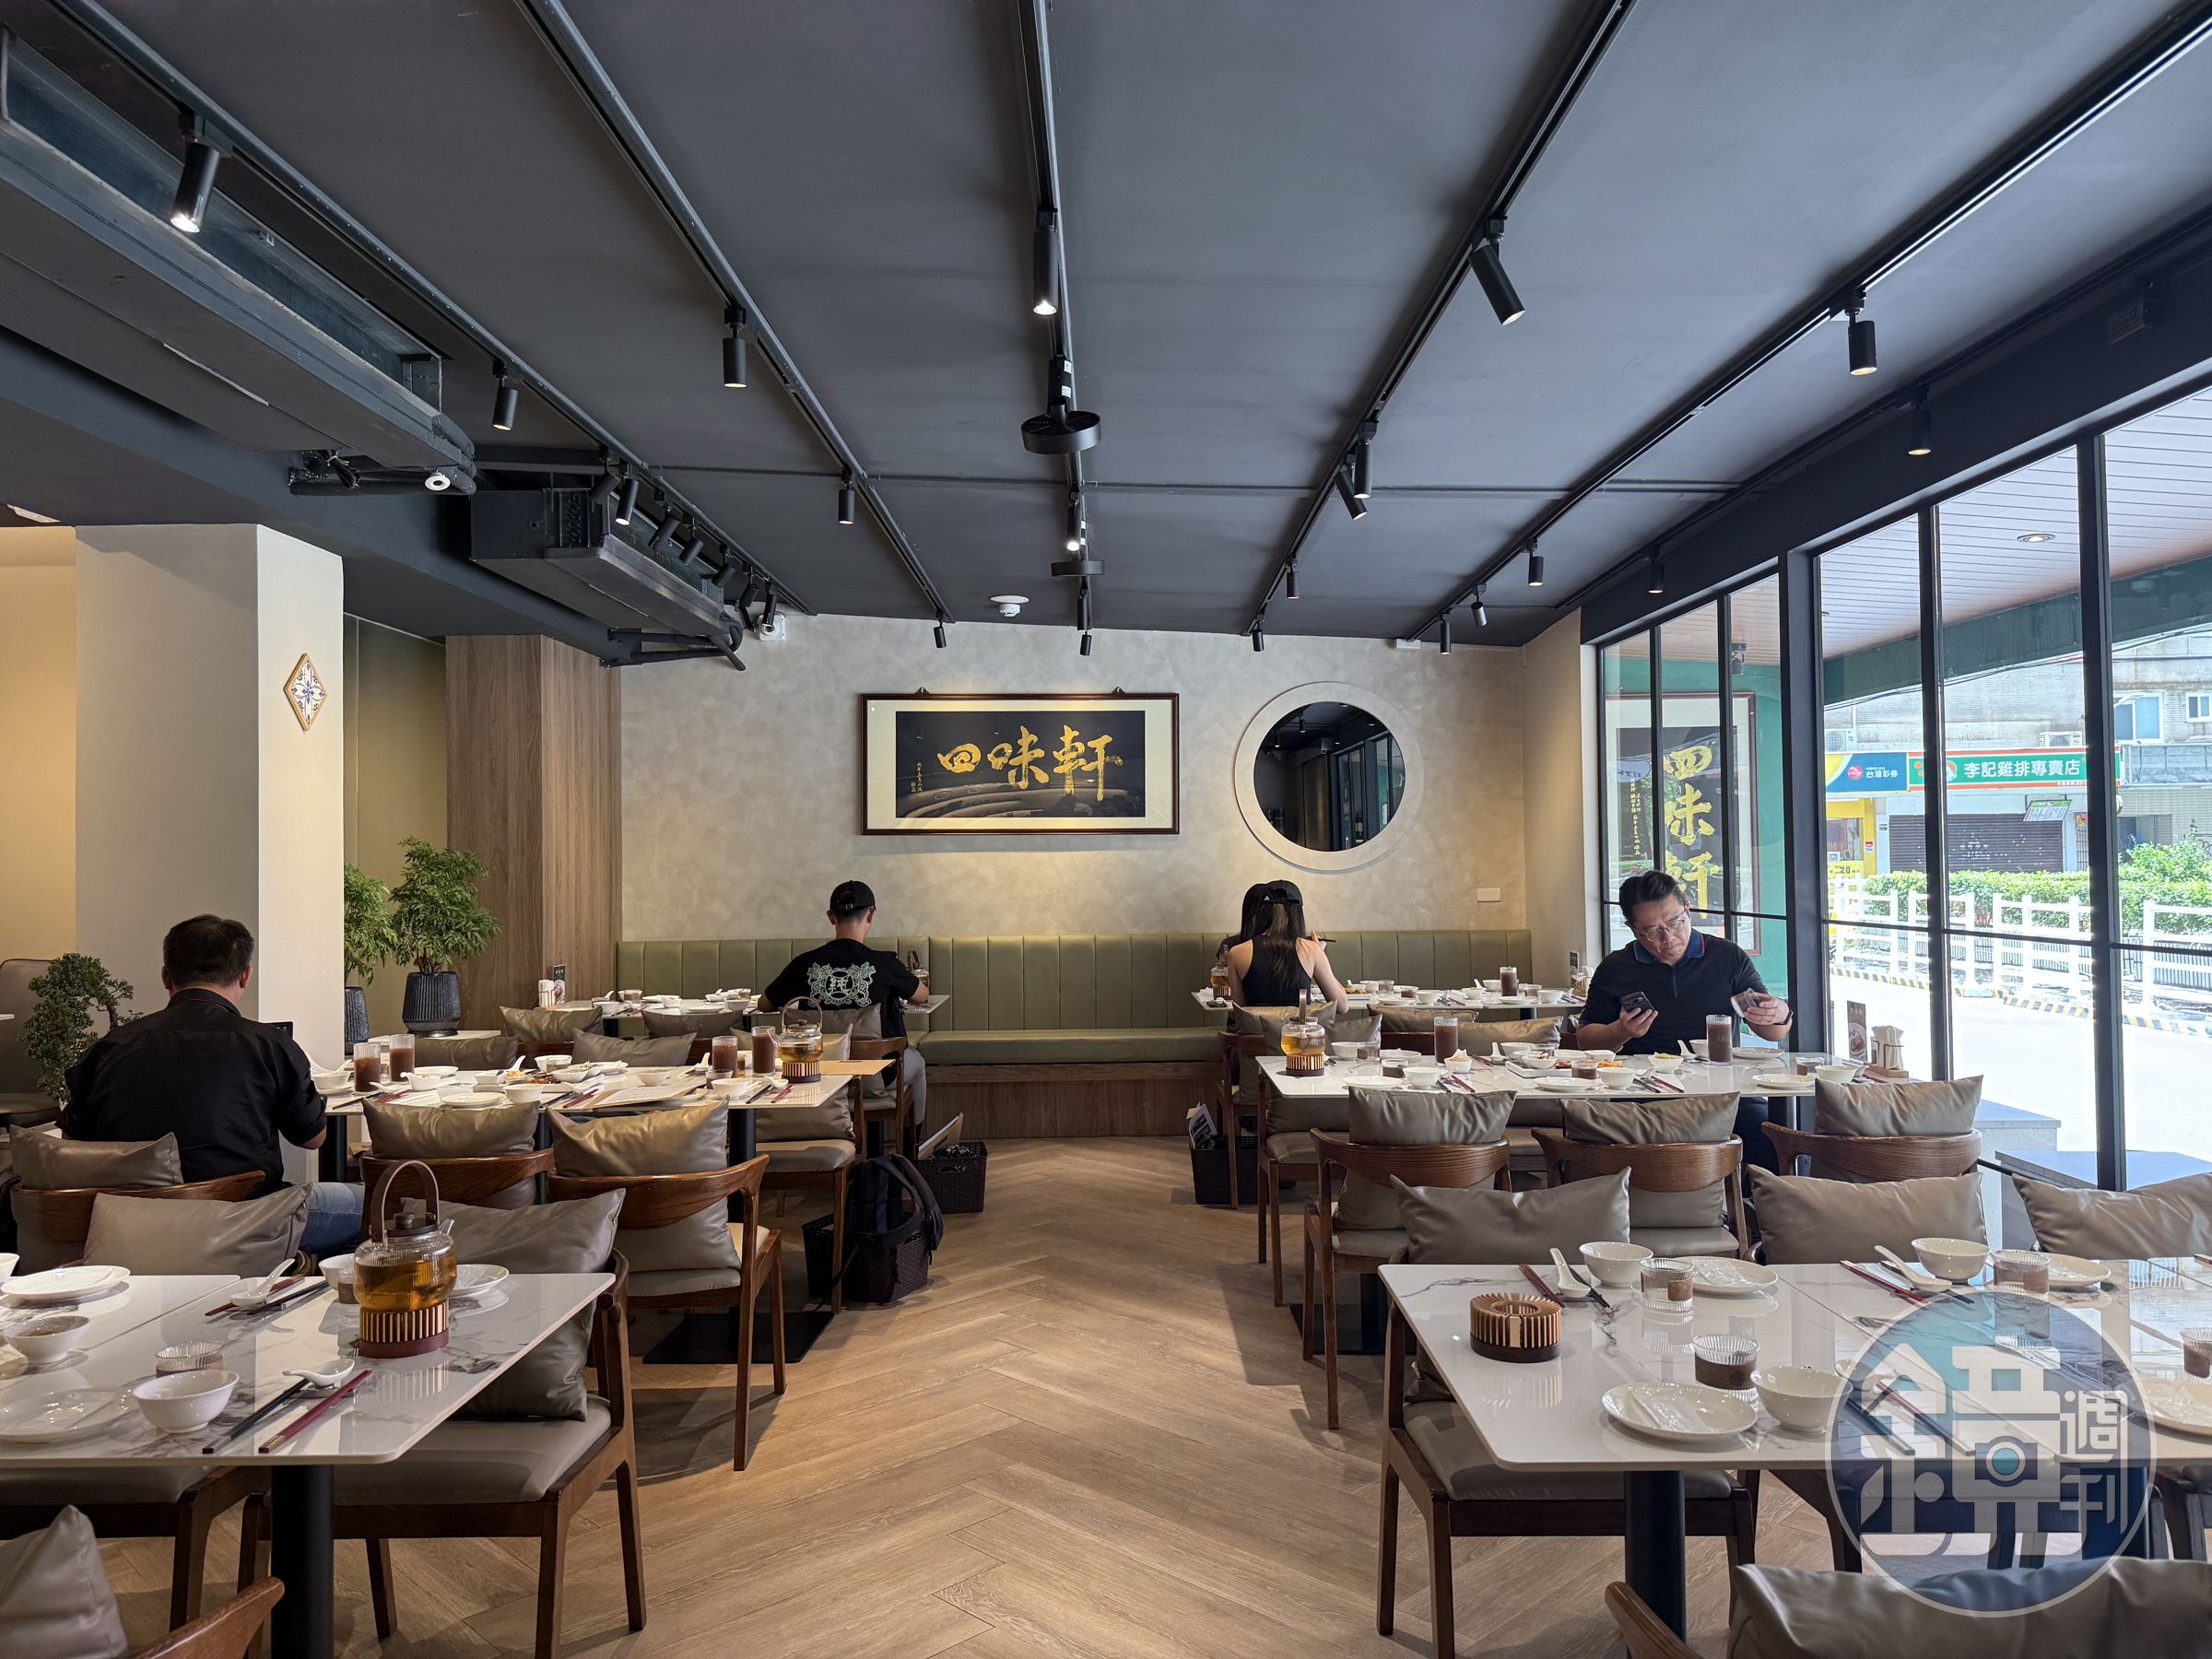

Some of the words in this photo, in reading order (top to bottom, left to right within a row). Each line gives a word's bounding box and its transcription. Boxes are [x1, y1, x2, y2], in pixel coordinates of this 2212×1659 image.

[1865, 770, 1899, 779] 台灣彩券
[1963, 759, 2080, 779] 李記雞排專賣店
